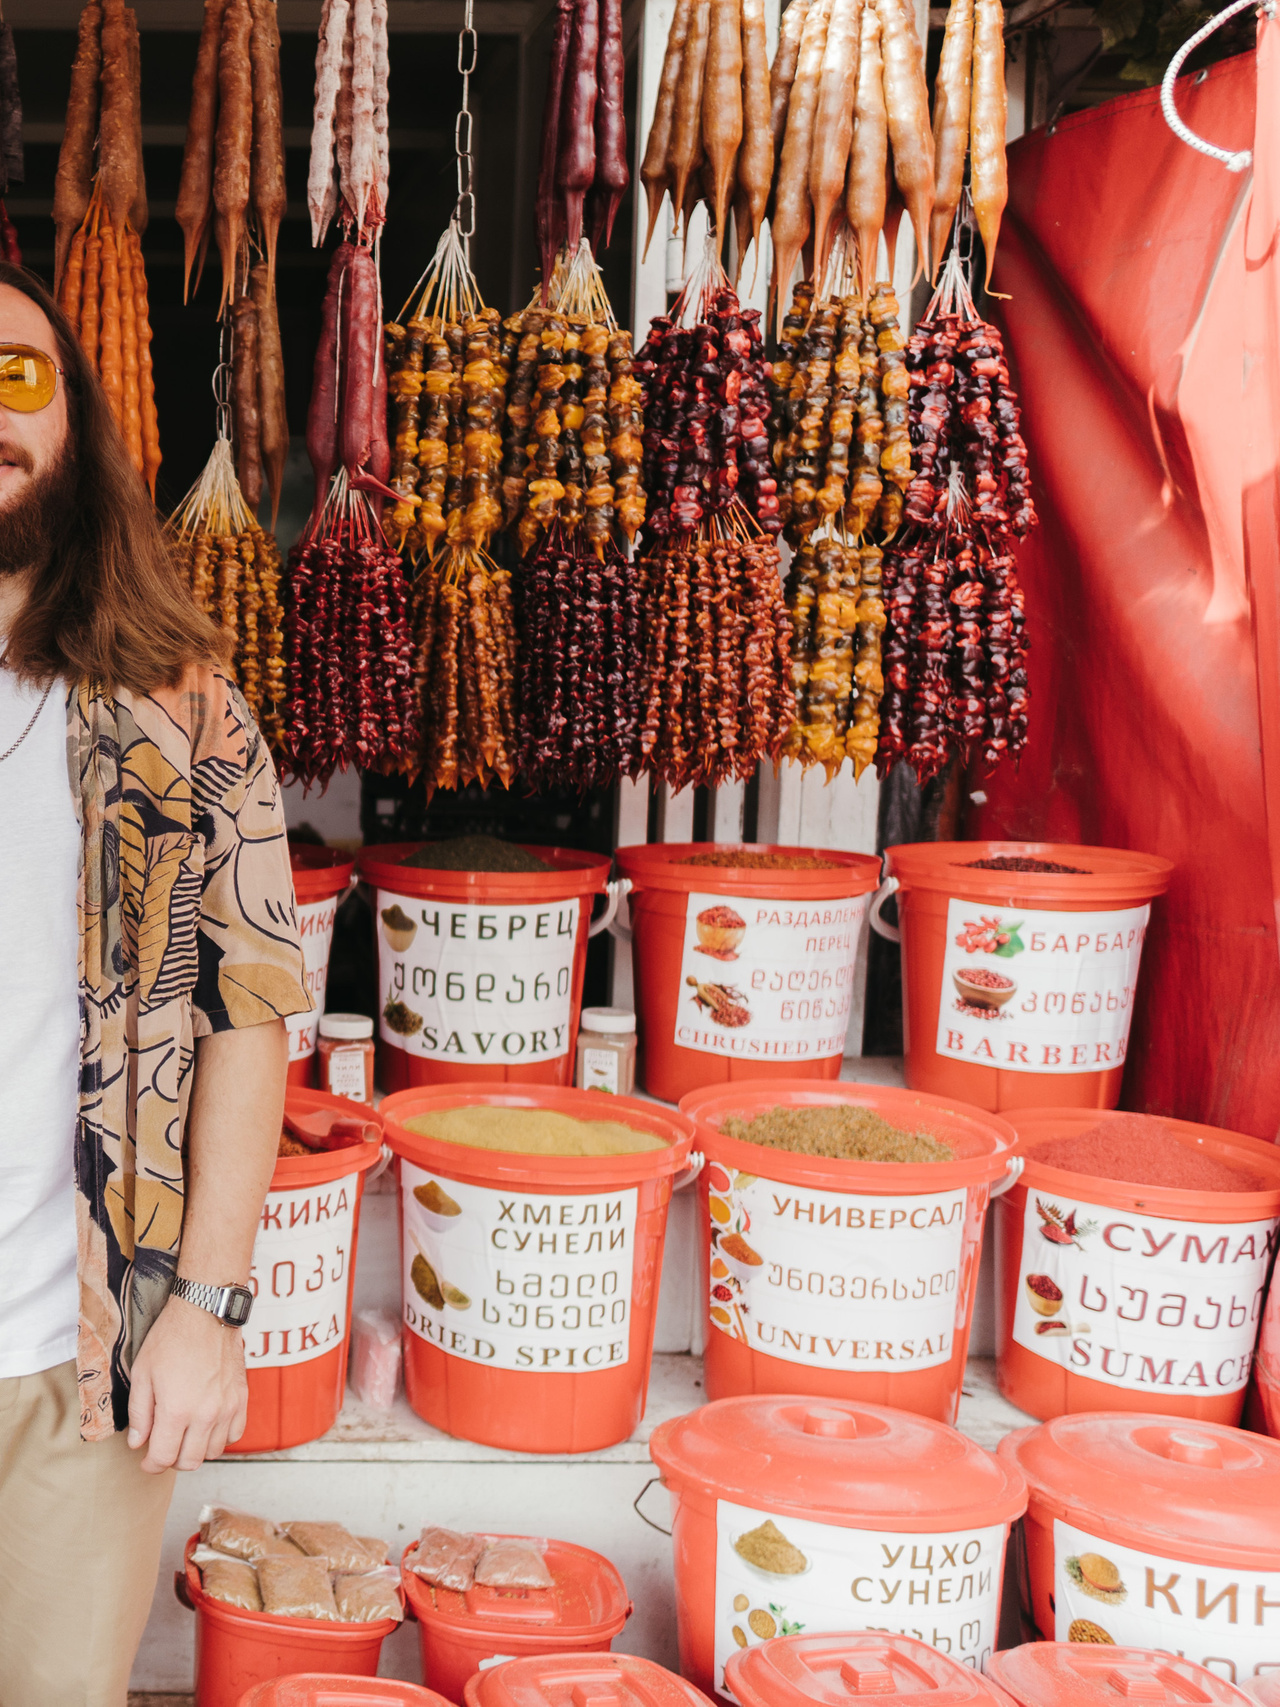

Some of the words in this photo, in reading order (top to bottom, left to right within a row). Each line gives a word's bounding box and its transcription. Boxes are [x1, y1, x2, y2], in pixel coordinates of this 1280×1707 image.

[421, 908, 573, 940] ЧЕБРЕЦ
[806, 935, 850, 952] ПЕРЕЦ
[1021, 986, 1136, 1014] კოწახუ
[421, 1024, 566, 1055] SAVORY
[498, 1199, 622, 1226] ХМЕЛИ
[772, 1194, 964, 1229] УНИВЕРСАЛ
[491, 1227, 625, 1254] СУНЕЛИ
[496, 1270, 618, 1298] ხმელი
[768, 1262, 956, 1301] უნივერსალი
[482, 1298, 625, 1330] სუნელი
[242, 1314, 340, 1358] JIKA
[406, 1303, 495, 1360] DRIED
[515, 1340, 624, 1367] SPICE
[756, 1320, 951, 1360] UNIVERSAL
[1070, 1338, 1255, 1387] SUMACH
[881, 1540, 982, 1575] УЦХО
[851, 1567, 992, 1605] СУНЕЛИ
